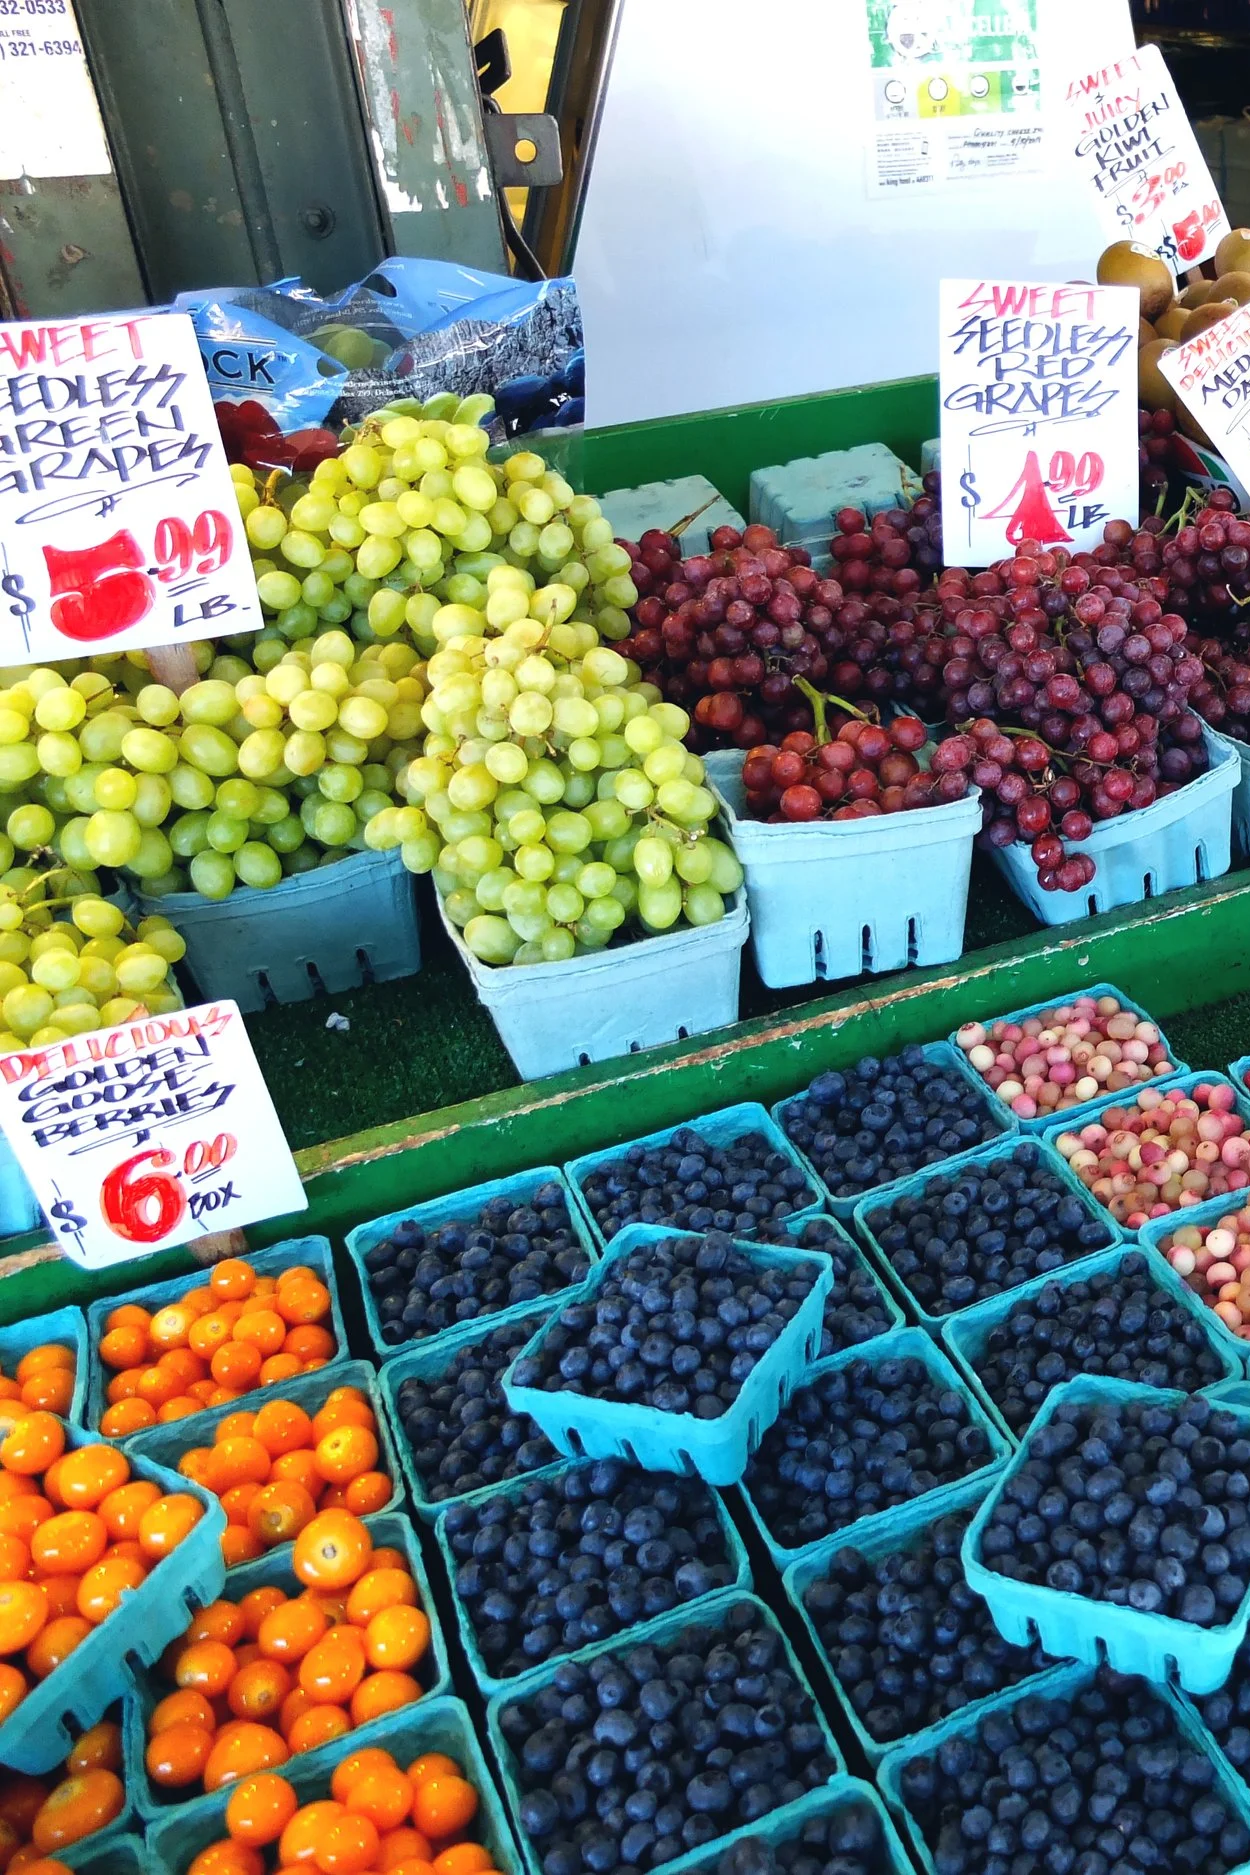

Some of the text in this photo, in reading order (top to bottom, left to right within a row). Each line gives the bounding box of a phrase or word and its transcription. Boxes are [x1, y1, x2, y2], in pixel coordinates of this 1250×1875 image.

[8, 40, 82, 57] 321-6394
[1065, 56, 1142, 103] SWEET
[1074, 92, 1170, 157] GOLDEN
[1080, 87, 1142, 135] JUICY
[1090, 137, 1166, 192] FRUIT
[1095, 126, 1152, 171] KIWI
[957, 282, 1105, 321] SWEET
[0, 317, 152, 371] WEET
[948, 315, 1134, 367] SEEDLESS
[977, 351, 1095, 383] RED
[943, 380, 1120, 418] GRAPES
[1068, 503, 1110, 529] LB
[0, 1006, 234, 1085] DELICIOUS
[18, 1034, 212, 1102] GOLDEN
[31, 1081, 237, 1148] BERRIES
[187, 1180, 243, 1220] BOX
